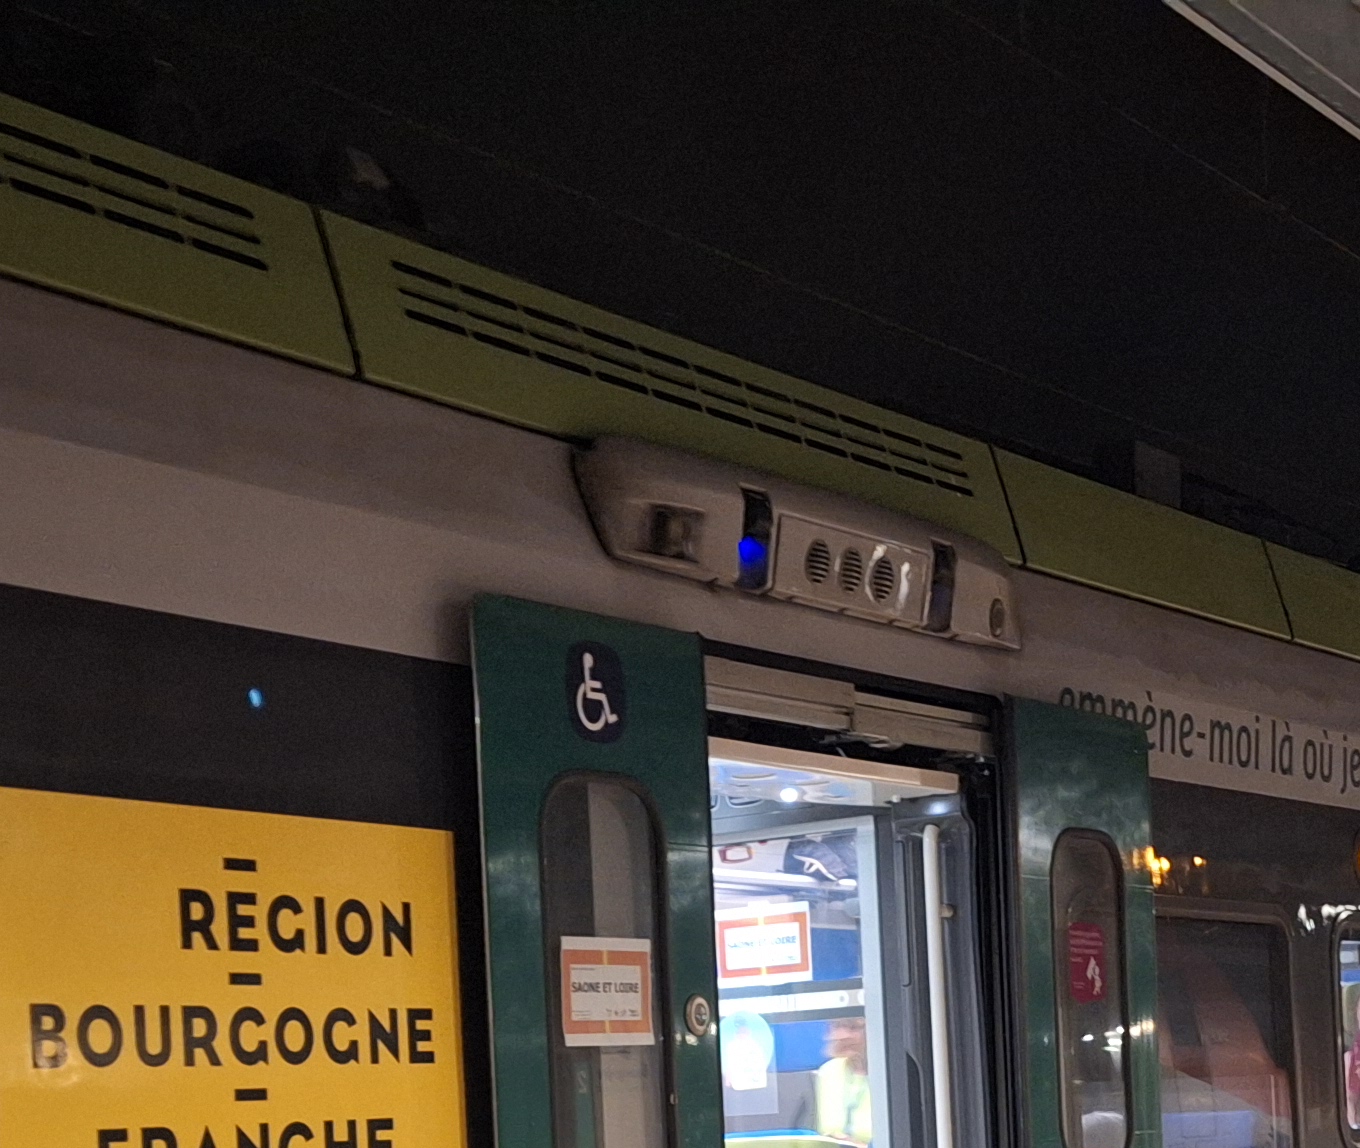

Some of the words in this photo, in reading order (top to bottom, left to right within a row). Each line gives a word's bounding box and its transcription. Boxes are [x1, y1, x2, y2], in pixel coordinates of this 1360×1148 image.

[1270, 720, 1294, 776] là
[1302, 729, 1333, 783] où
[603, 982, 613, 993] ET
[614, 982, 639, 993] LOIRE
[28, 1002, 436, 1069] BOURGOGNE
